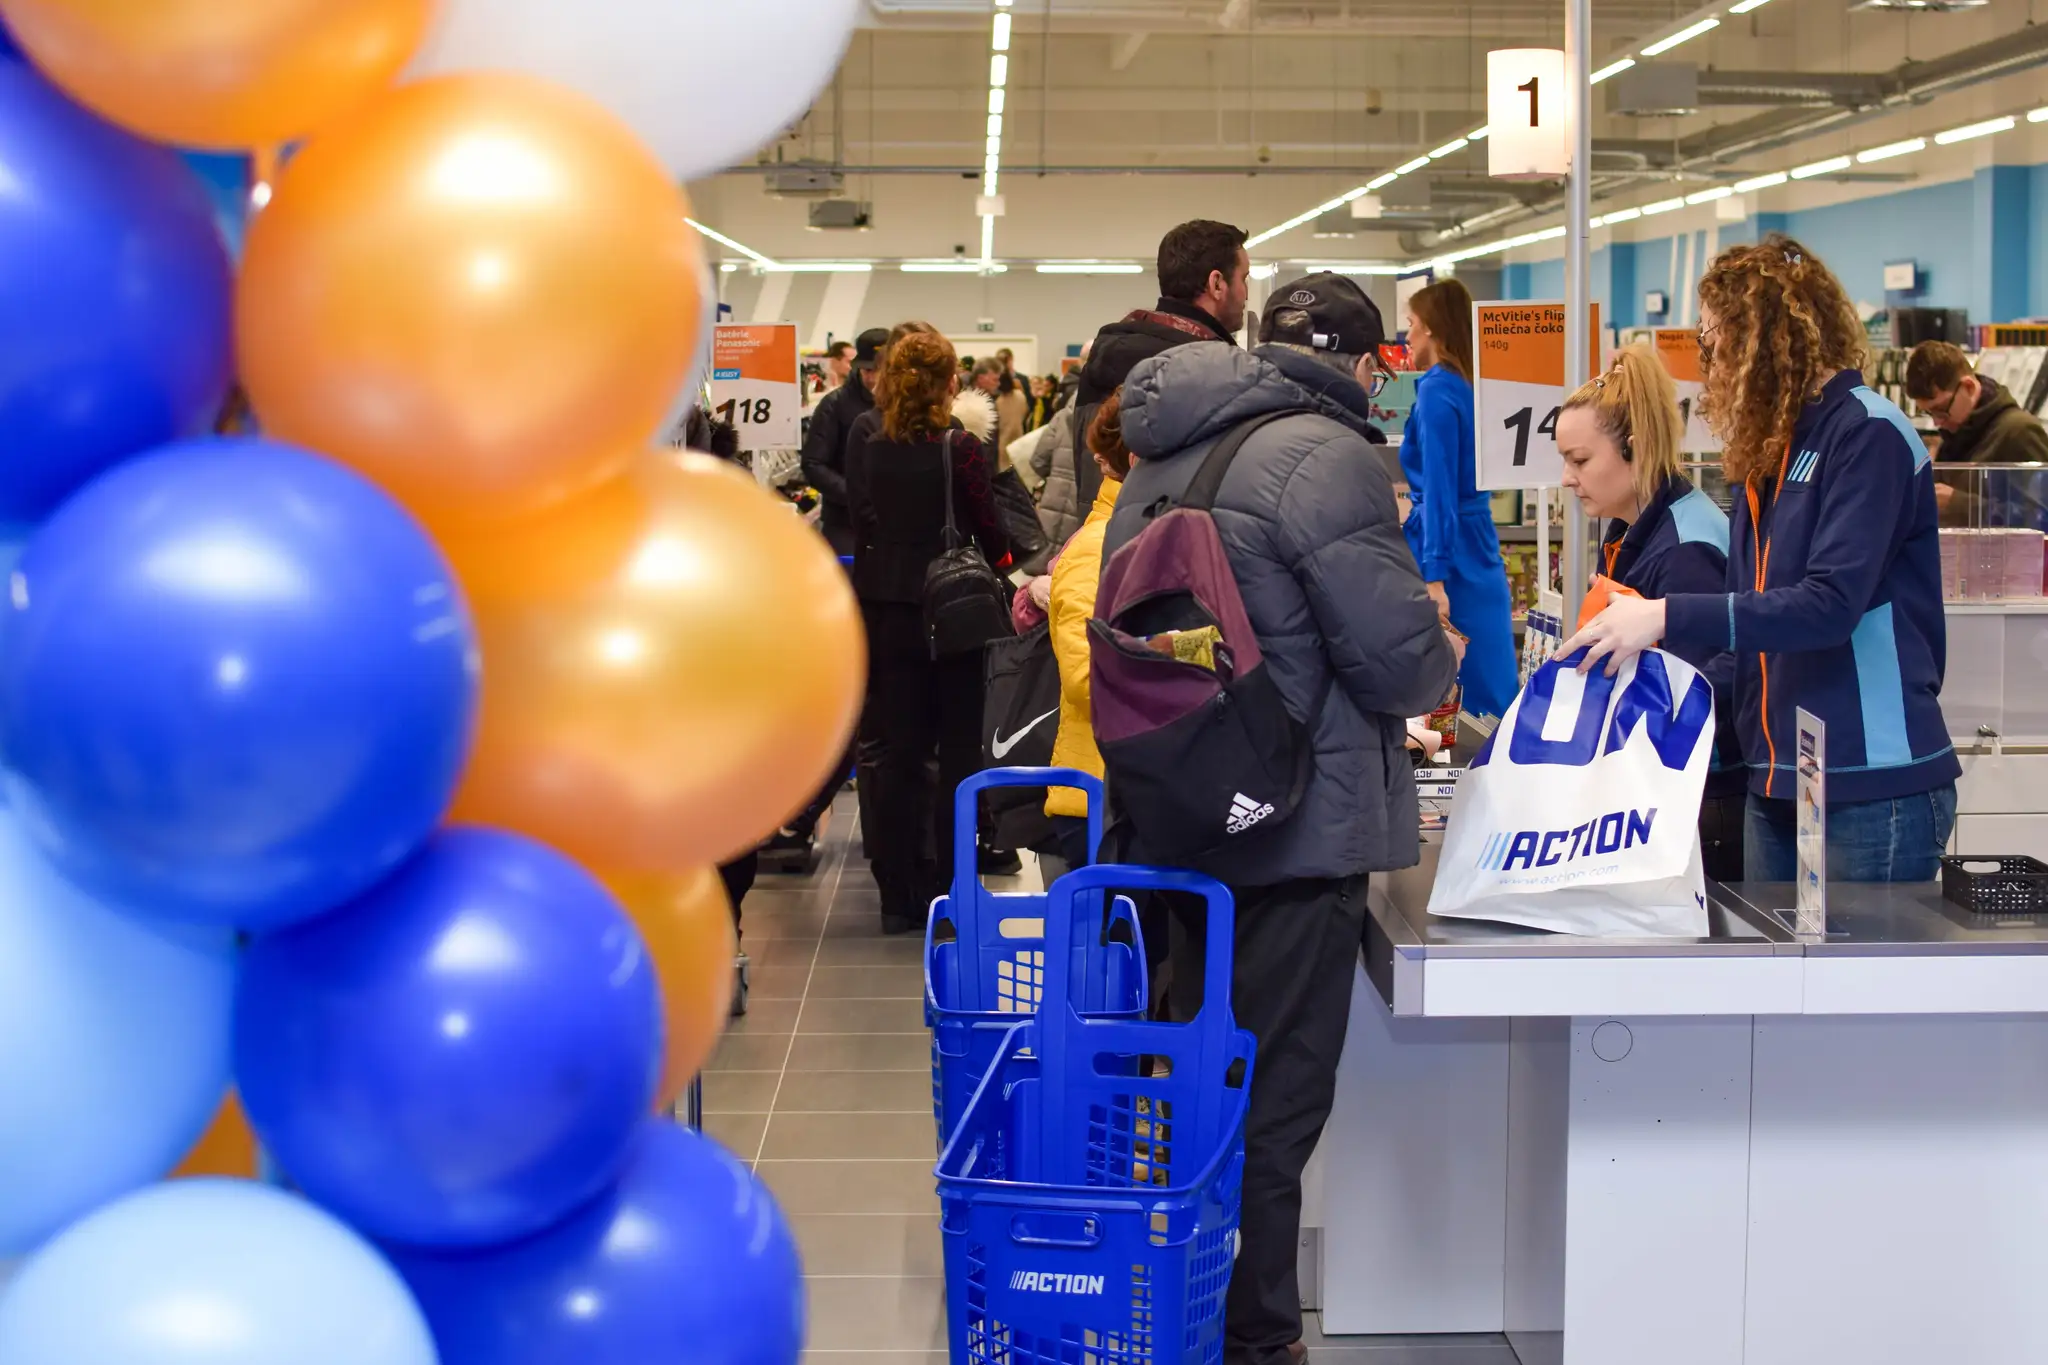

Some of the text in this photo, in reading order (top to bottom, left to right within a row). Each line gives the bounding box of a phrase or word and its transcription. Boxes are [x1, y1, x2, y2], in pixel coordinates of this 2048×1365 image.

[1517, 76, 1539, 127] 1
[1483, 311, 1541, 323] McVitie's
[1483, 322, 1565, 335] mliečna čoko
[716, 339, 761, 347] Panasonic
[1483, 340, 1509, 351] 140g
[1226, 803, 1275, 833] adidas
[1501, 807, 1658, 871] ACTION
[1021, 1271, 1105, 1295] ACTION
